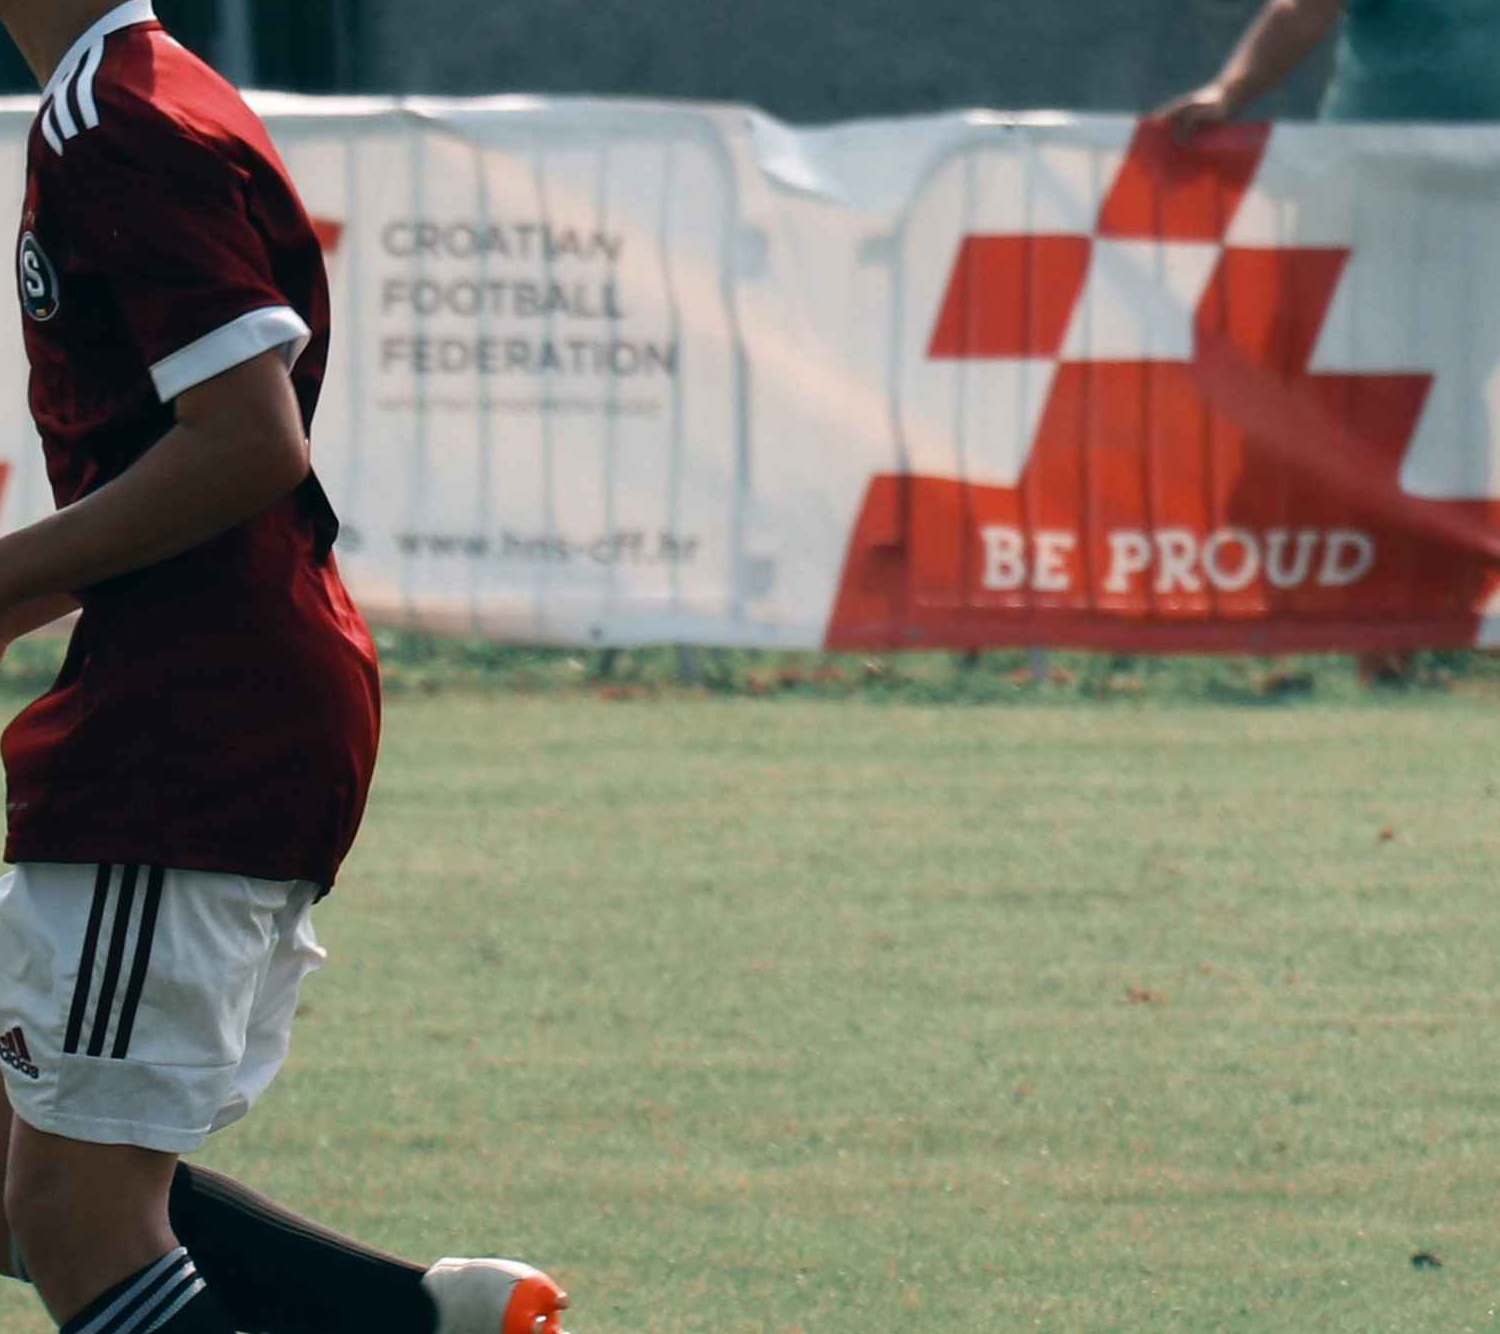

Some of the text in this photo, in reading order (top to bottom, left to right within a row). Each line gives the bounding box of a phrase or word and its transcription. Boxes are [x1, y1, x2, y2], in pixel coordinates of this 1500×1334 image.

[380, 221, 625, 261] CROATIAN
[380, 279, 623, 319] FOOTBALL
[380, 335, 678, 379] FEDERATION
[980, 524, 1377, 595] BE PROUD
